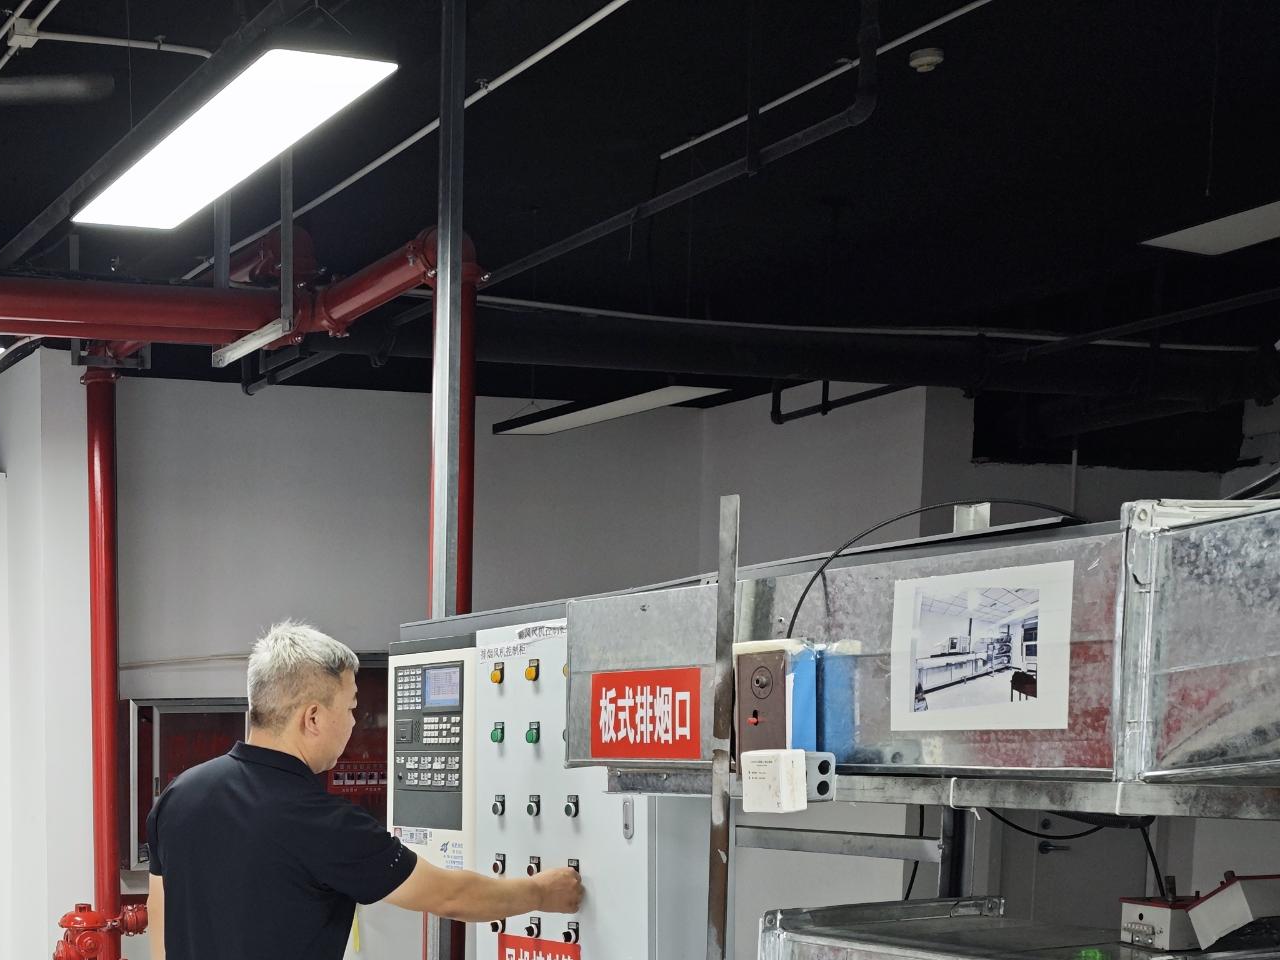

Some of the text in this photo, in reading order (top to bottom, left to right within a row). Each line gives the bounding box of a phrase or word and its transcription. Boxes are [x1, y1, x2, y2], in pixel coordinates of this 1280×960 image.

[599, 685, 690, 745] 板式排烟口
